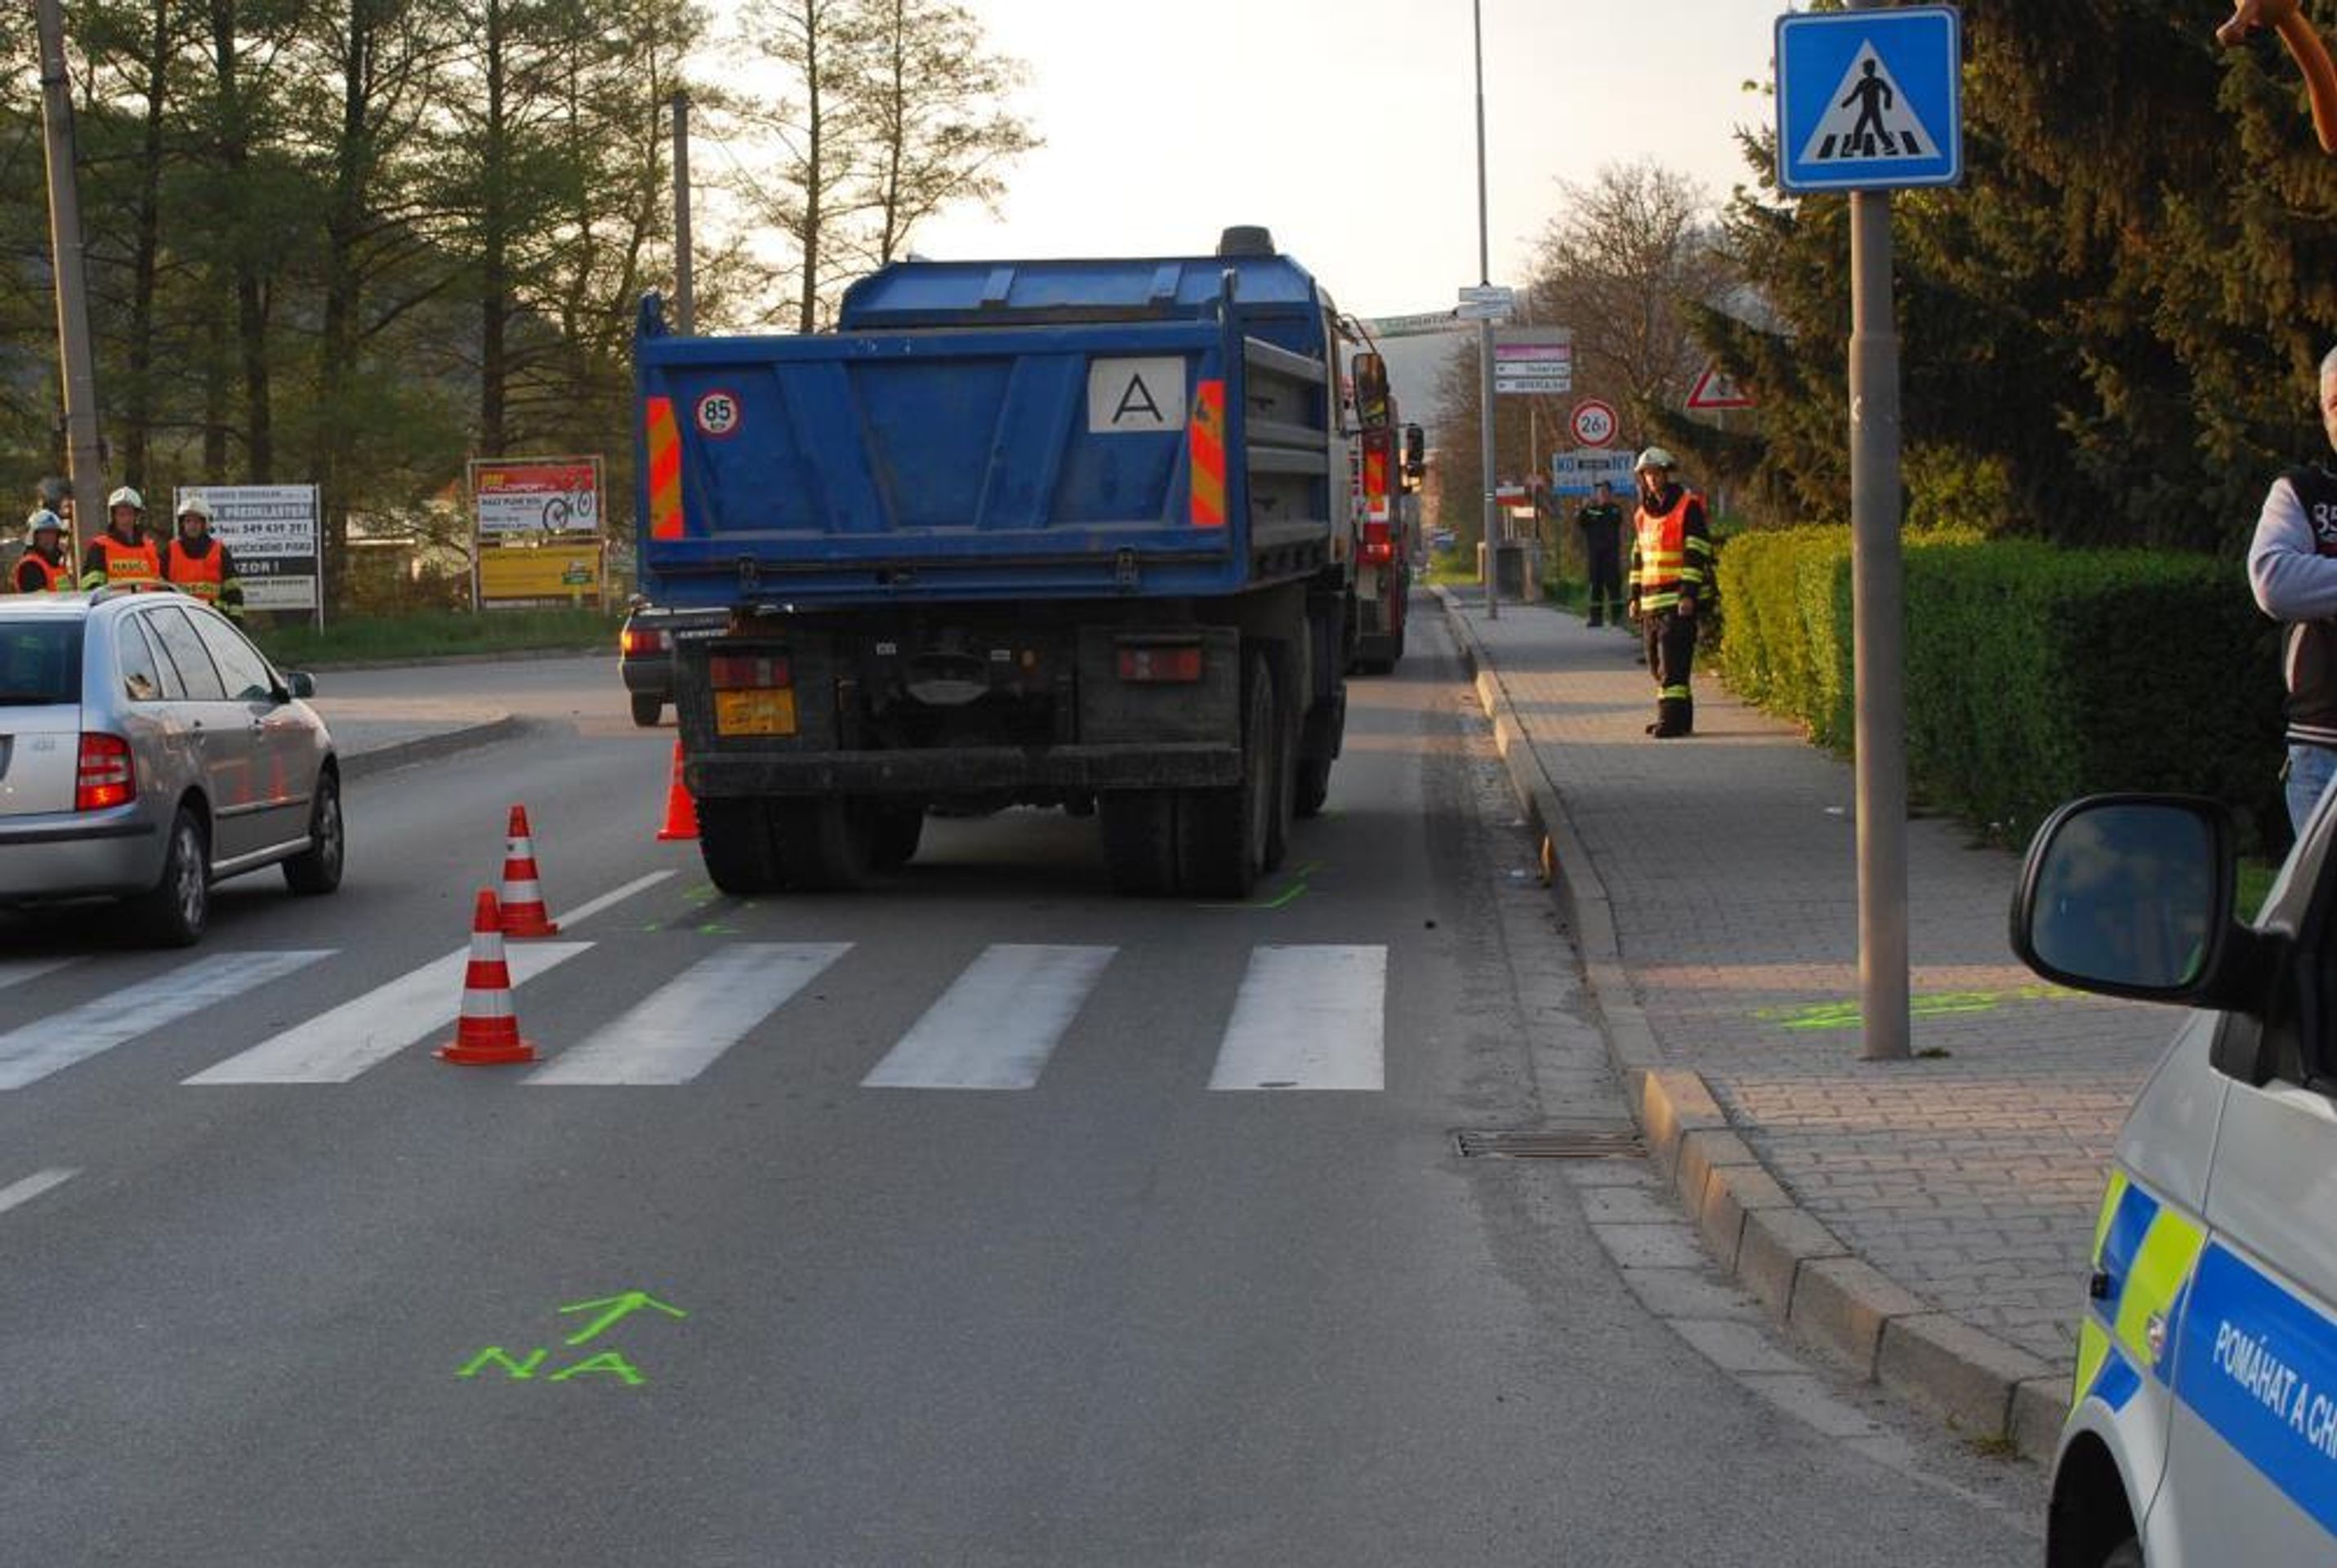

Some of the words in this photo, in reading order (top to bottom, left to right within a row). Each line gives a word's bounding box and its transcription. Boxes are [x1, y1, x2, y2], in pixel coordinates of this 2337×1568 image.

[705, 399, 731, 421] 85
[1112, 372, 1164, 424] A
[2213, 1319, 2299, 1418] POMÁHAT
[2288, 1382, 2309, 1435] A
